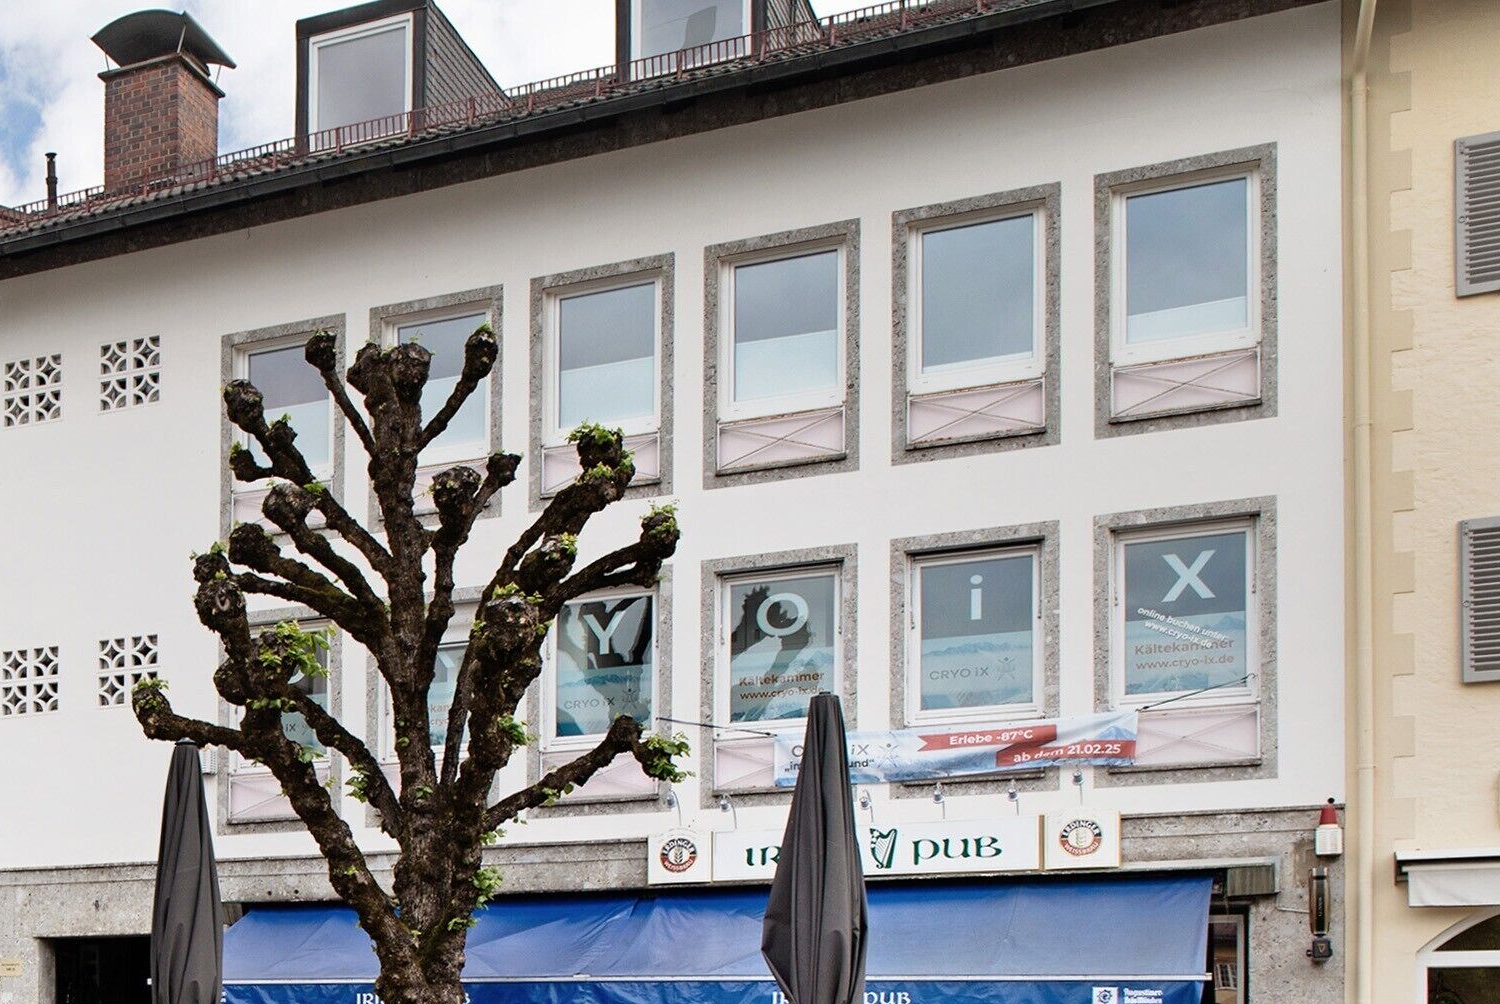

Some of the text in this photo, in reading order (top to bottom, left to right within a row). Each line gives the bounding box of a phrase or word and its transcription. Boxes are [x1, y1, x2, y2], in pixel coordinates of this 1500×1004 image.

[582, 549, 1217, 656] Y O i X
[1137, 607, 1166, 622] online
[1166, 614, 1200, 634] buchen
[1135, 654, 1235, 671] www.cryo-ix.de
[929, 666, 990, 681] CRYO iX
[563, 698, 599, 711] CRYO
[949, 734, 993, 746] Erlebe
[1013, 742, 1122, 763] ab dem 21.02.25
